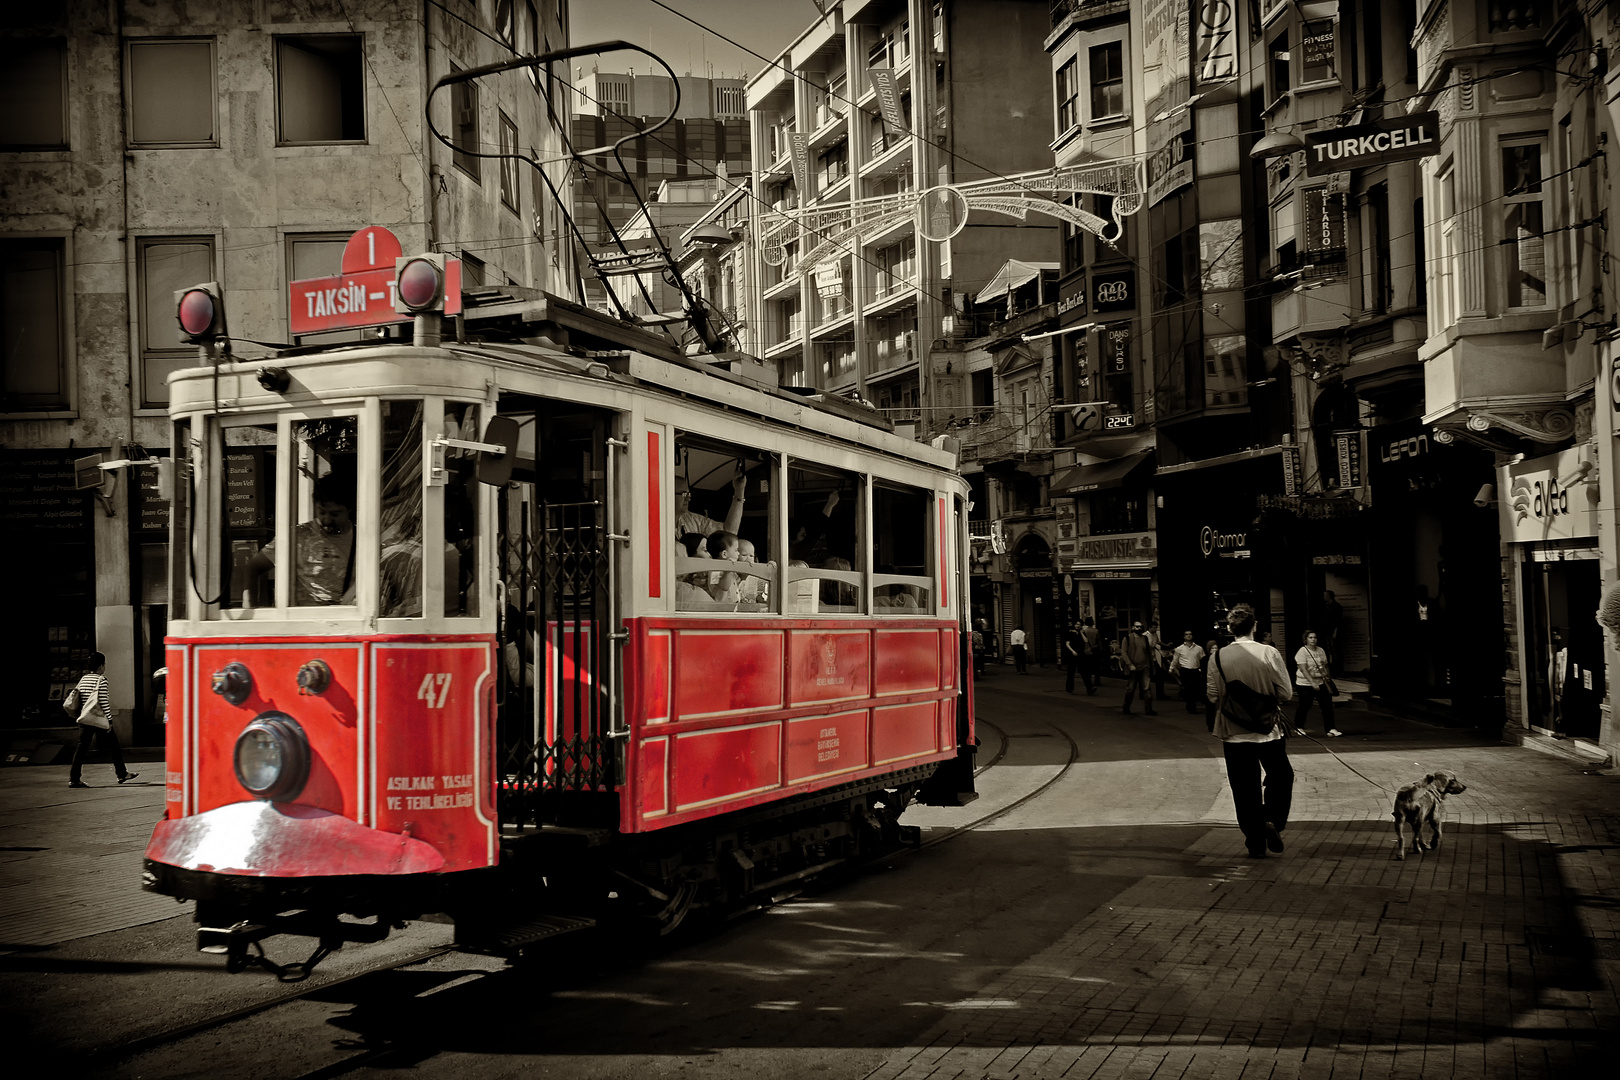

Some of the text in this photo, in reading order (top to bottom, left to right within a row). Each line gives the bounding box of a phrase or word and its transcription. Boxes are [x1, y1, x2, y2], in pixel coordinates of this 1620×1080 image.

[1313, 126, 1433, 162] TURKCELL
[367, 232, 375, 265] 1
[417, 673, 452, 708] 47
[387, 796, 402, 810] VE
